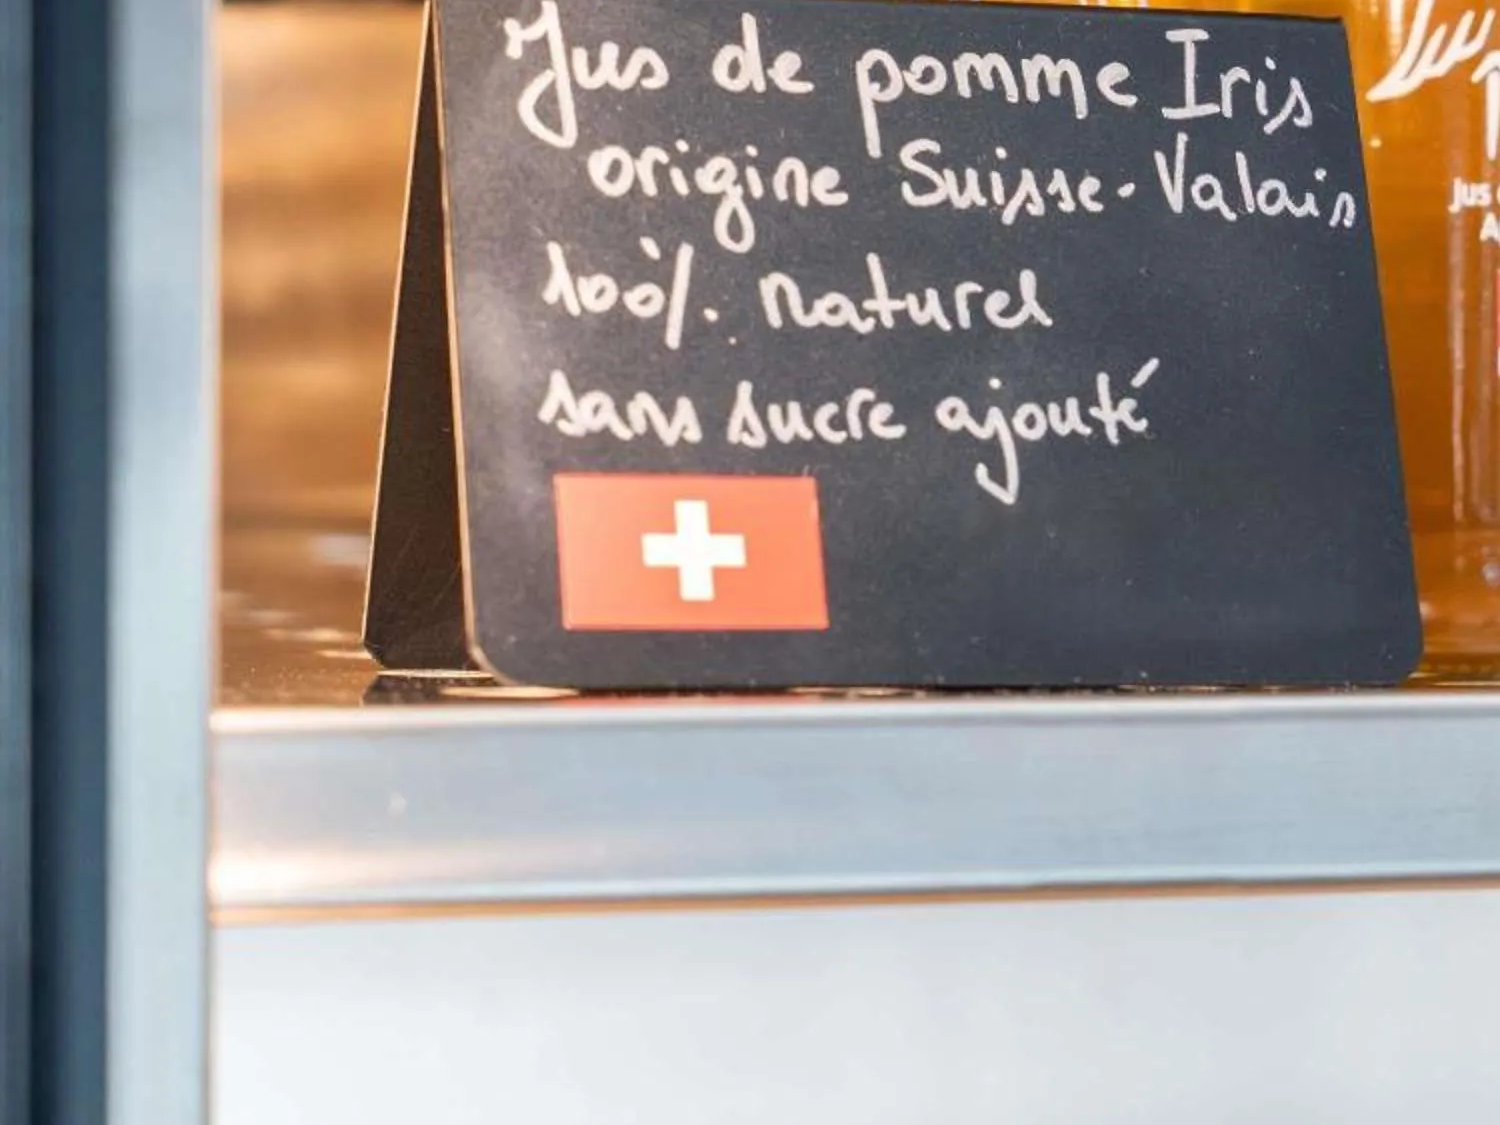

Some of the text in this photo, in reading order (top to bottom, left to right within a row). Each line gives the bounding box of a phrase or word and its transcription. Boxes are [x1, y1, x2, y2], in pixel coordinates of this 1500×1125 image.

[712, 11, 815, 95] de
[855, 47, 1138, 160] pomme
[1161, 27, 1314, 136] Iris
[587, 139, 850, 254] origine
[1448, 177, 1492, 214] Jus
[537, 356, 1161, 505] sans sucre ajouté
